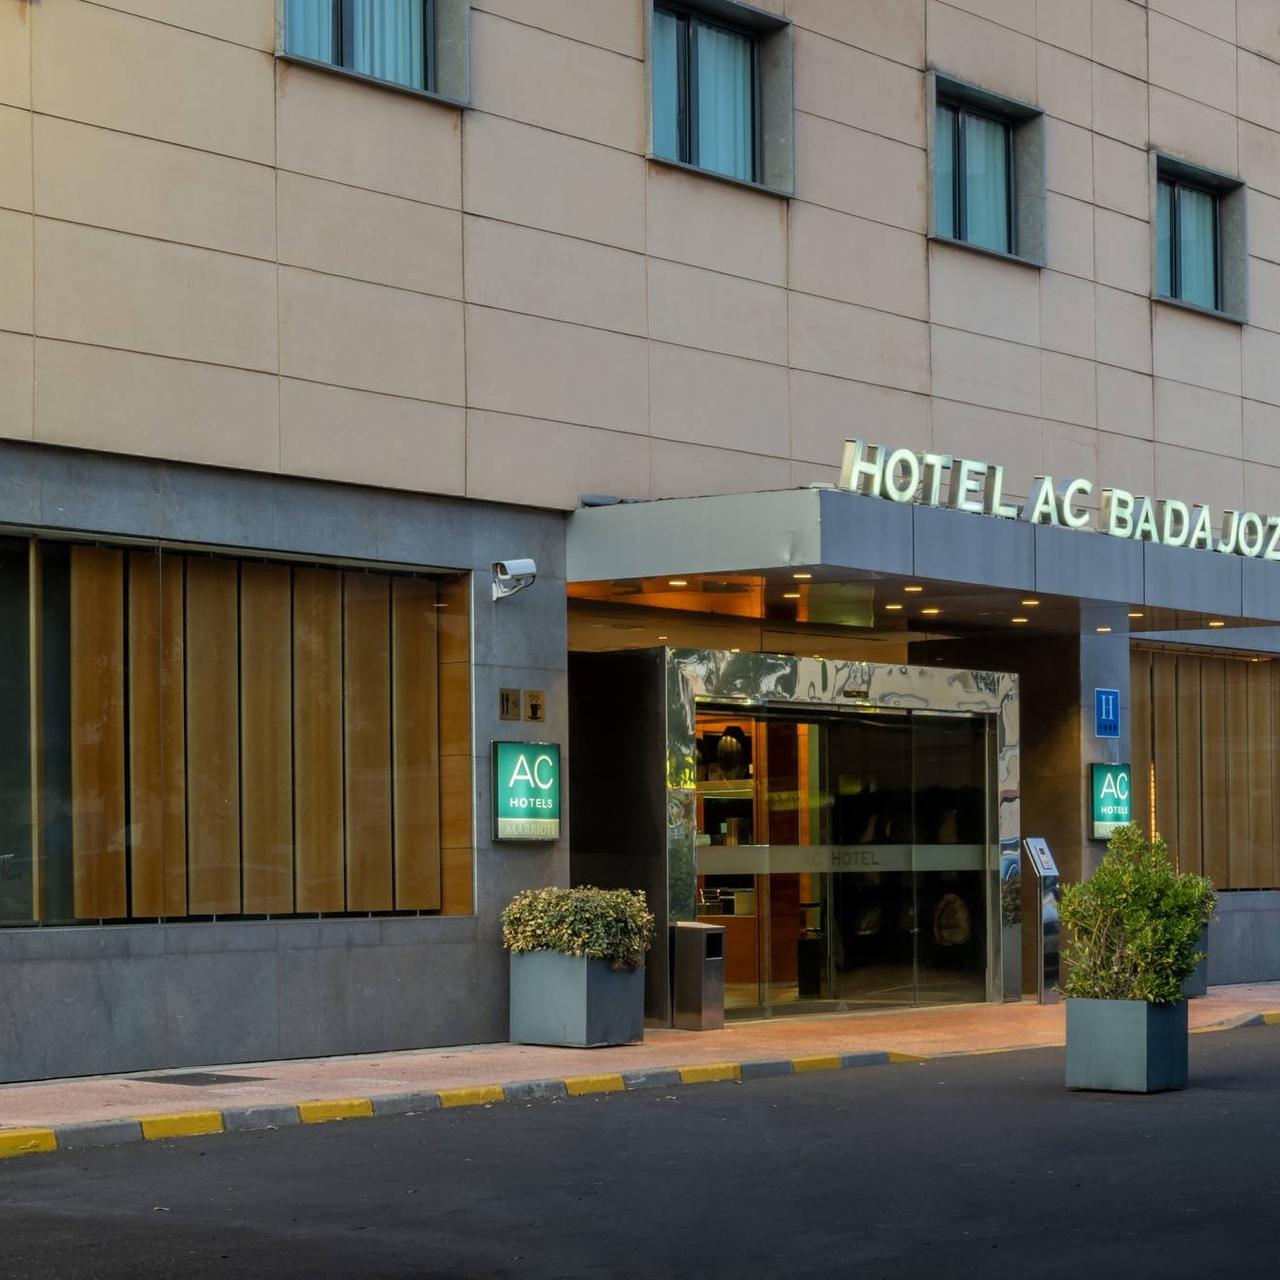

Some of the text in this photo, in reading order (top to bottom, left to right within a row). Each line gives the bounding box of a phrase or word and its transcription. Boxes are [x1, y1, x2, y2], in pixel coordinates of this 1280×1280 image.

[843, 439, 1018, 518] HOTEL
[1031, 475, 1093, 528] AC
[1100, 694, 1115, 720] H
[508, 754, 554, 790] AC
[1100, 772, 1129, 800] AC
[509, 798, 554, 809] HOTELS
[1100, 806, 1128, 815] HOTELS
[831, 851, 881, 867] HOTEL
